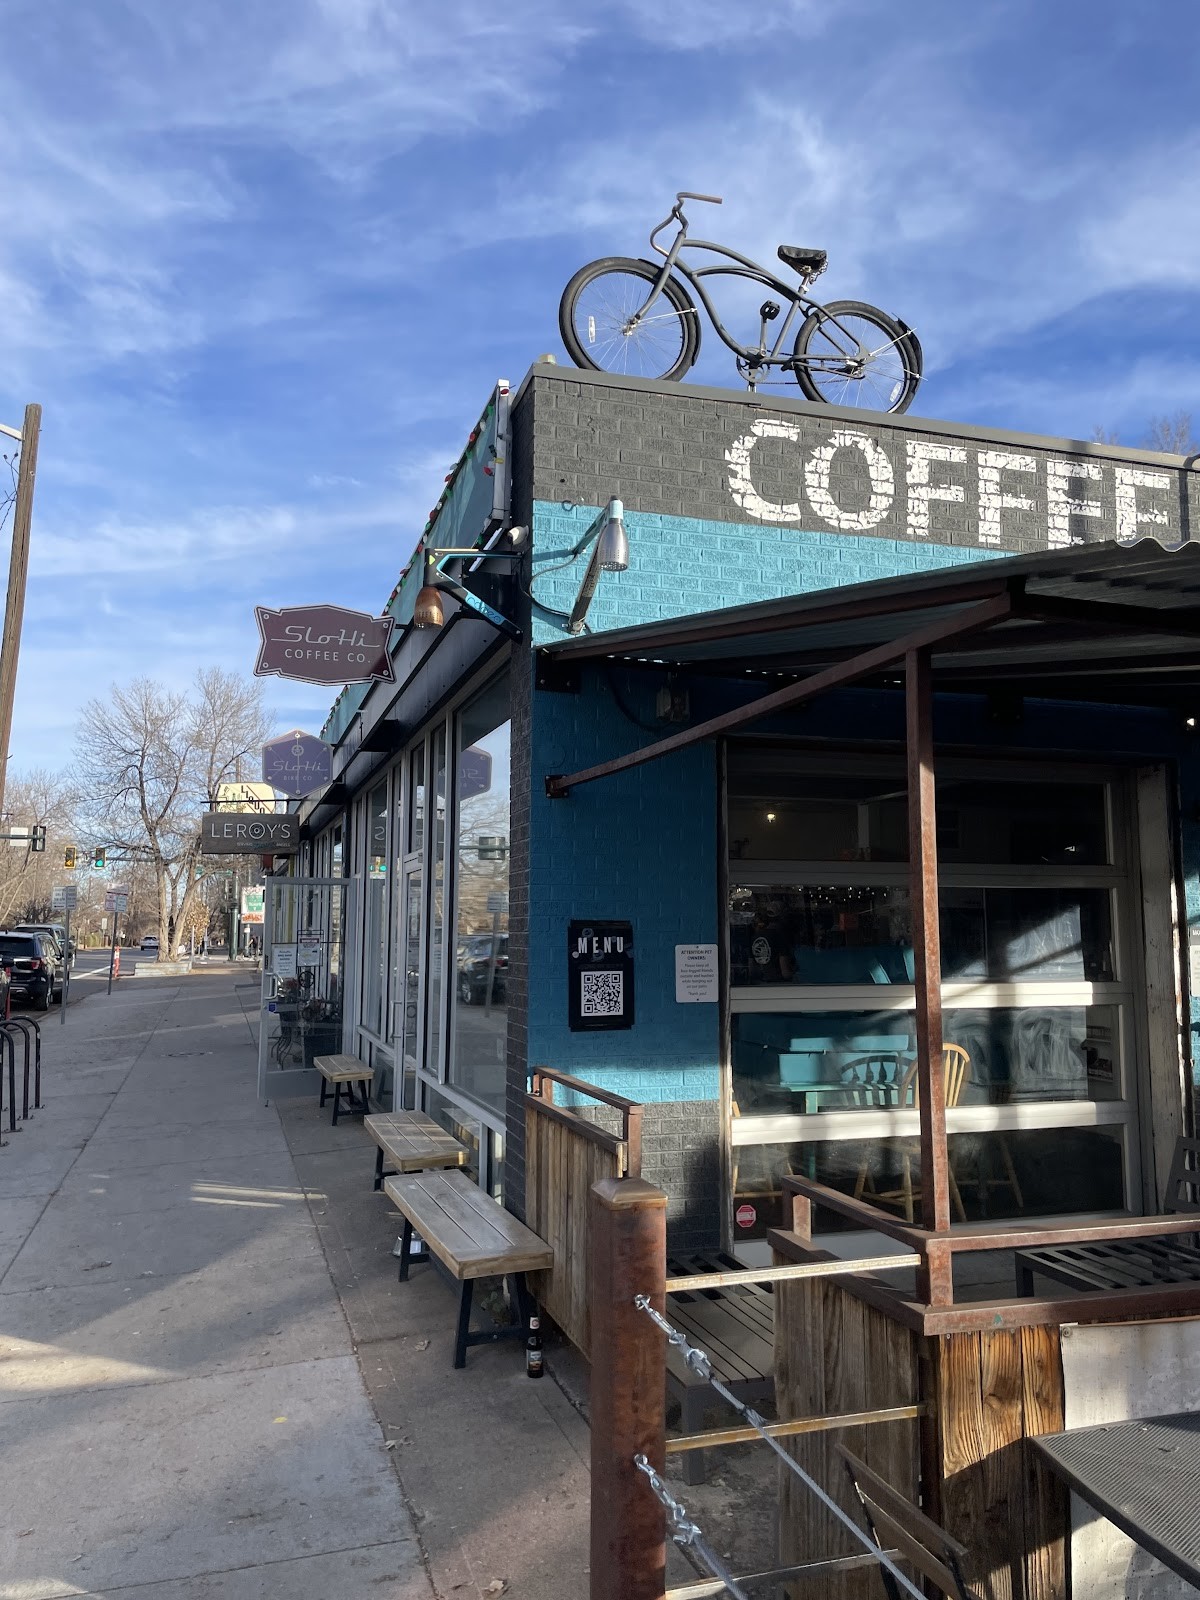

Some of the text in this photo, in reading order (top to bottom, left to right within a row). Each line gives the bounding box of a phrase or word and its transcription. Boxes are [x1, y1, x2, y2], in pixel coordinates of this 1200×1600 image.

[724, 418, 1171, 549] COFFEE
[271, 625, 380, 648] SloHi
[284, 648, 371, 663] COFFEE CO.
[211, 822, 291, 840] LEROY'S
[578, 936, 624, 954] MENU
